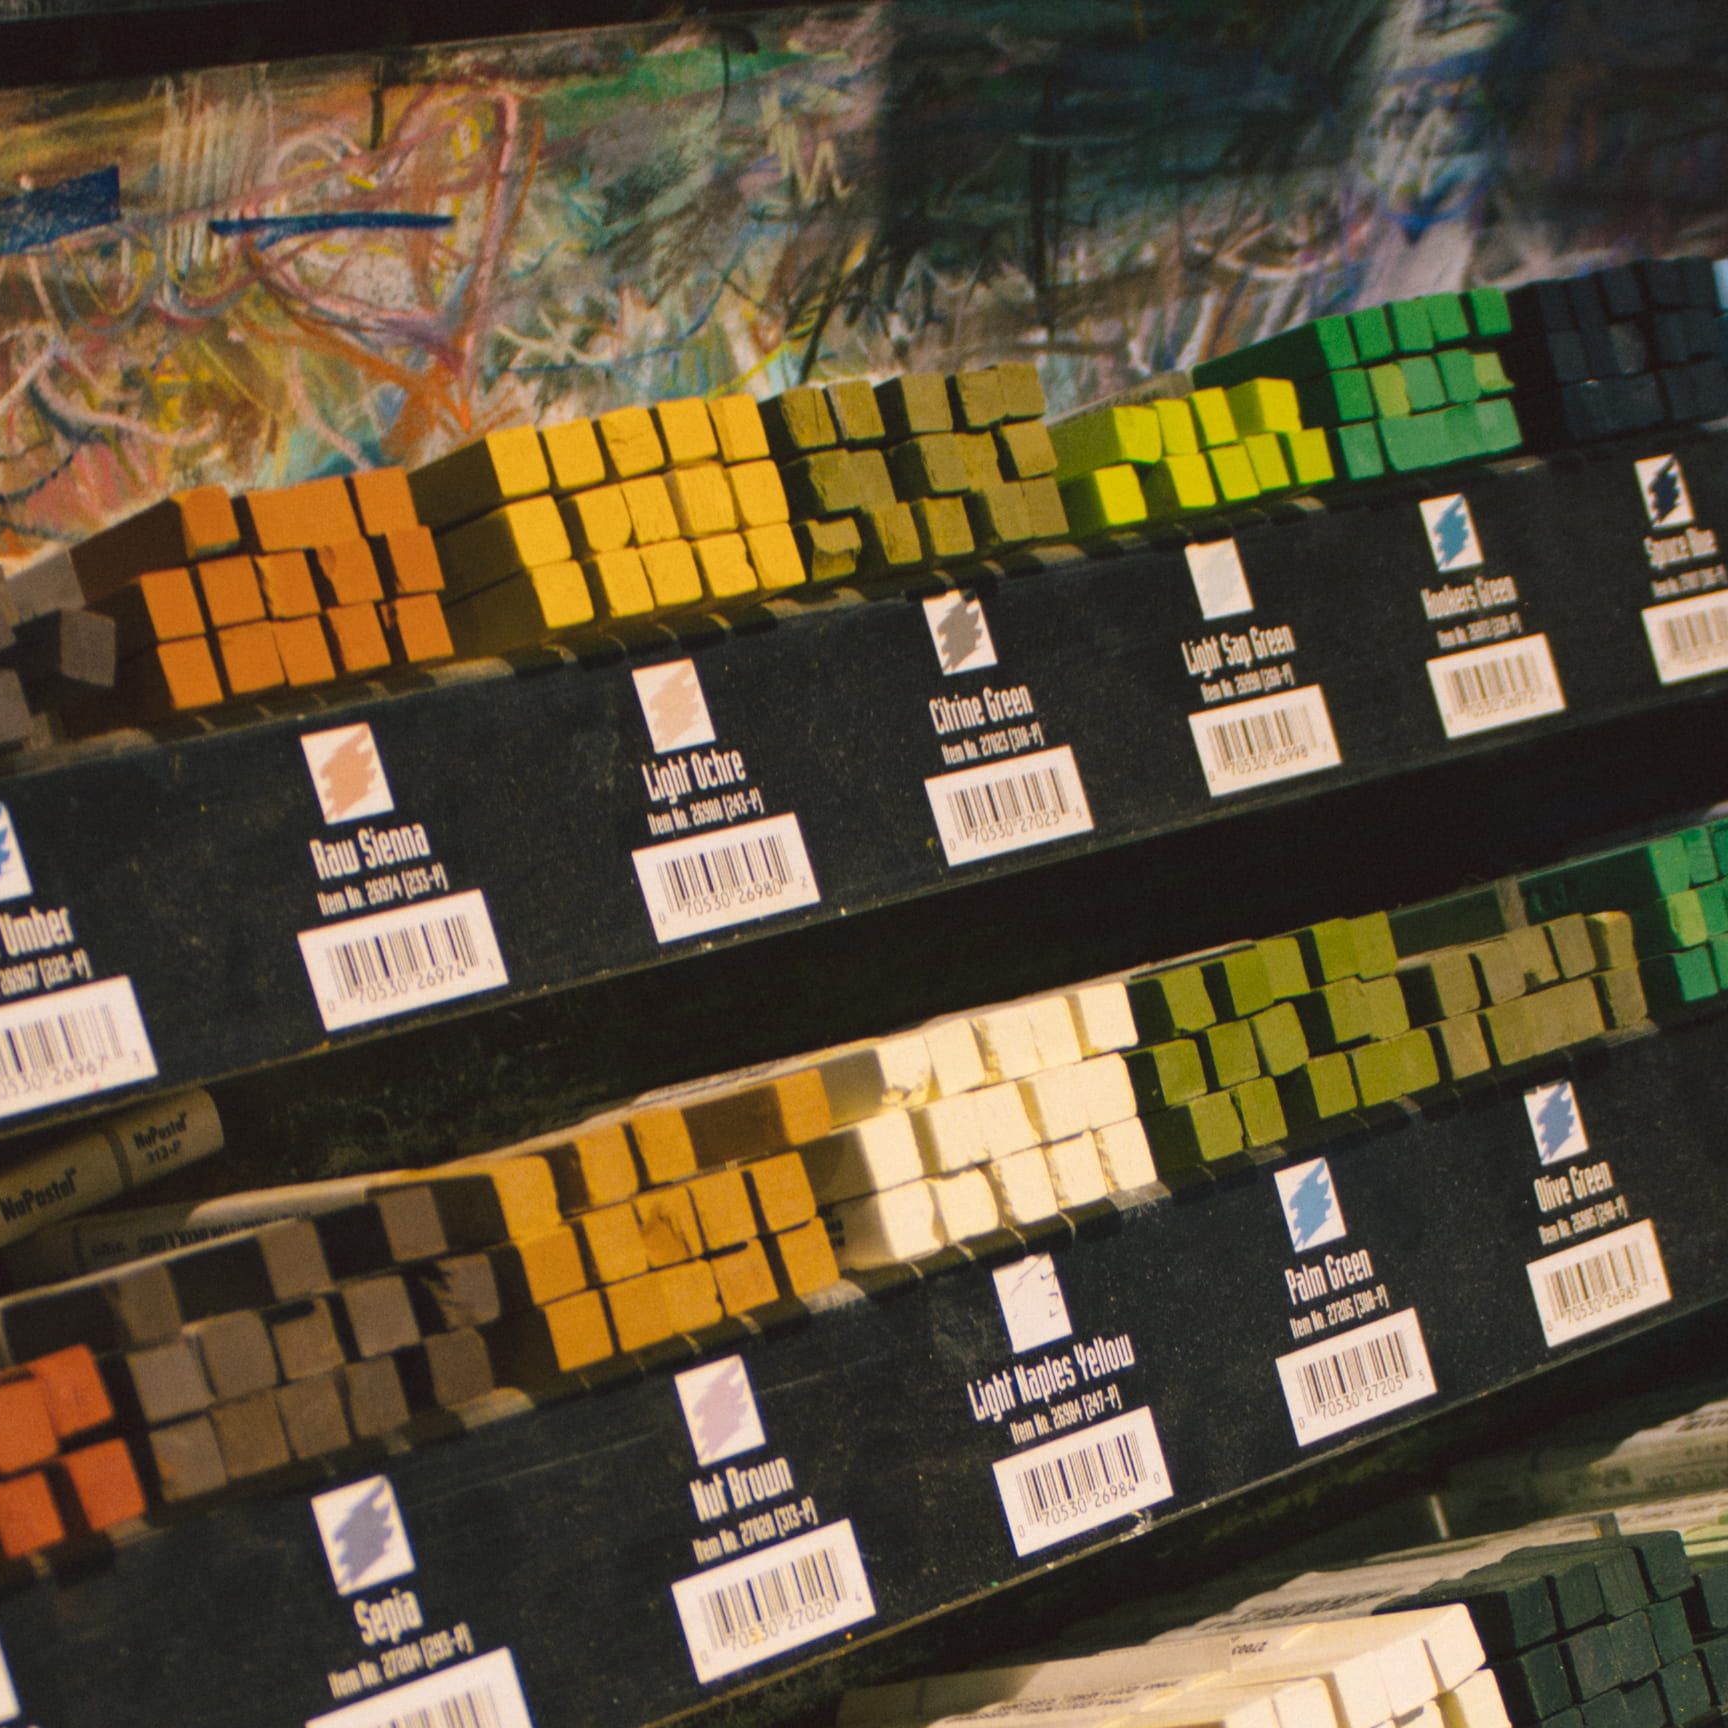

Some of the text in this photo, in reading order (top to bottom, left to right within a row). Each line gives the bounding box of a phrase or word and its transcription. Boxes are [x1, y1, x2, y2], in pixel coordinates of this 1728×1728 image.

[1475, 576, 1517, 608] Green
[1181, 625, 1295, 678] Light Sap Green
[929, 685, 1034, 734] Citrine Green
[642, 749, 746, 804] Light Ochre
[941, 745, 964, 764] Item
[647, 813, 674, 835] Item
[672, 808, 690, 829] No.
[690, 798, 724, 825] 26980
[310, 824, 430, 879] Raw Sienna
[317, 892, 346, 915] Item
[345, 886, 365, 908] No.
[365, 875, 402, 905] 26974
[0, 1169, 77, 1224] NuPastel
[1534, 1162, 1613, 1212] Olive Green
[1285, 1249, 1373, 1304] Palm Green
[1290, 1317, 1312, 1338] Item
[967, 1335, 1135, 1422] Light Naples Yellow
[1010, 1384, 1122, 1444] Item No. 26984 (247-P)
[690, 1458, 793, 1521] Nut Brown
[1041, 1476, 1137, 1528] 70530 26984
[693, 1537, 721, 1563] Item
[720, 1530, 740, 1553] No.
[739, 1513, 776, 1546] 27020
[354, 1589, 422, 1644] Sepia
[329, 1670, 361, 1698] Item
